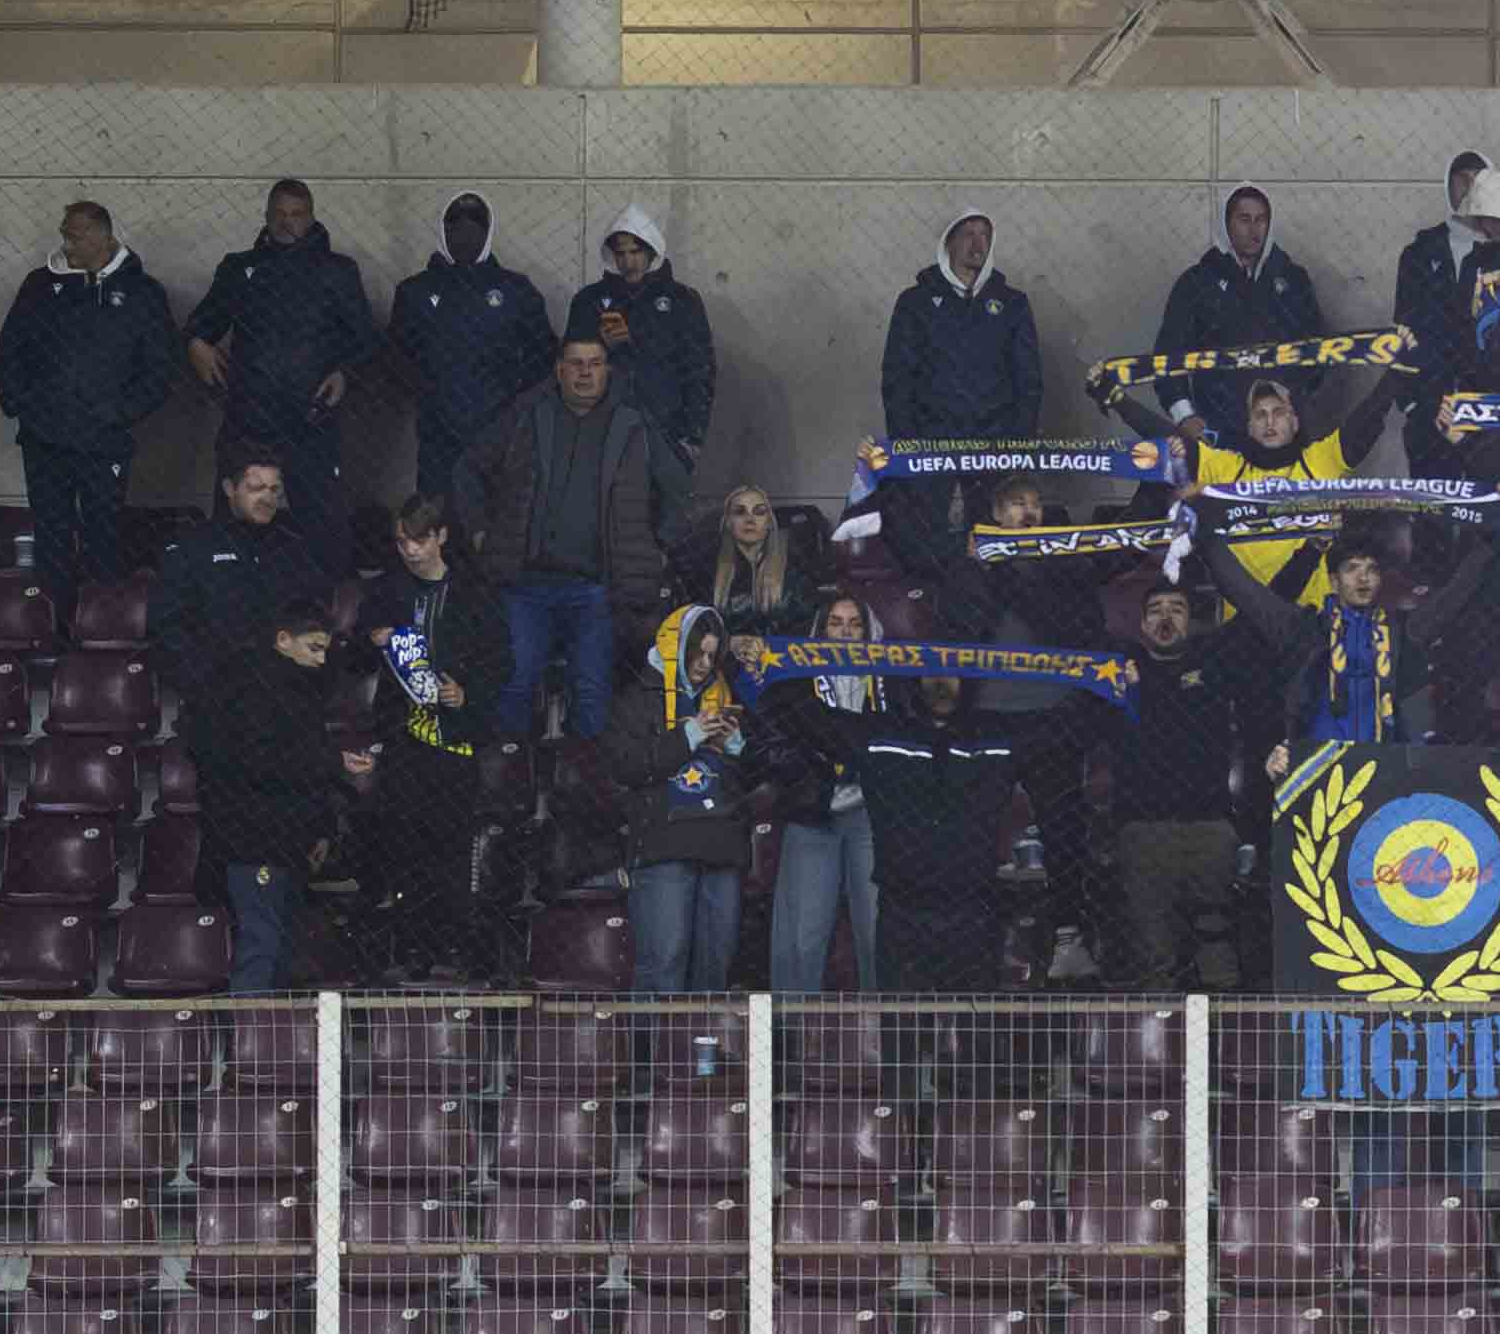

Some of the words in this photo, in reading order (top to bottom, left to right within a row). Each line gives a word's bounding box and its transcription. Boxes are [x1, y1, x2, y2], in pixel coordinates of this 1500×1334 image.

[908, 456, 956, 473] UEFA
[961, 453, 1035, 471] EUROPA
[1040, 454, 1112, 472] LEAGUE
[1235, 478, 1291, 496] UEFA
[1389, 478, 1477, 498] LEAGUE
[1227, 505, 1258, 520] 2014
[787, 641, 924, 668] ΑΣΤΕΡΑΣ
